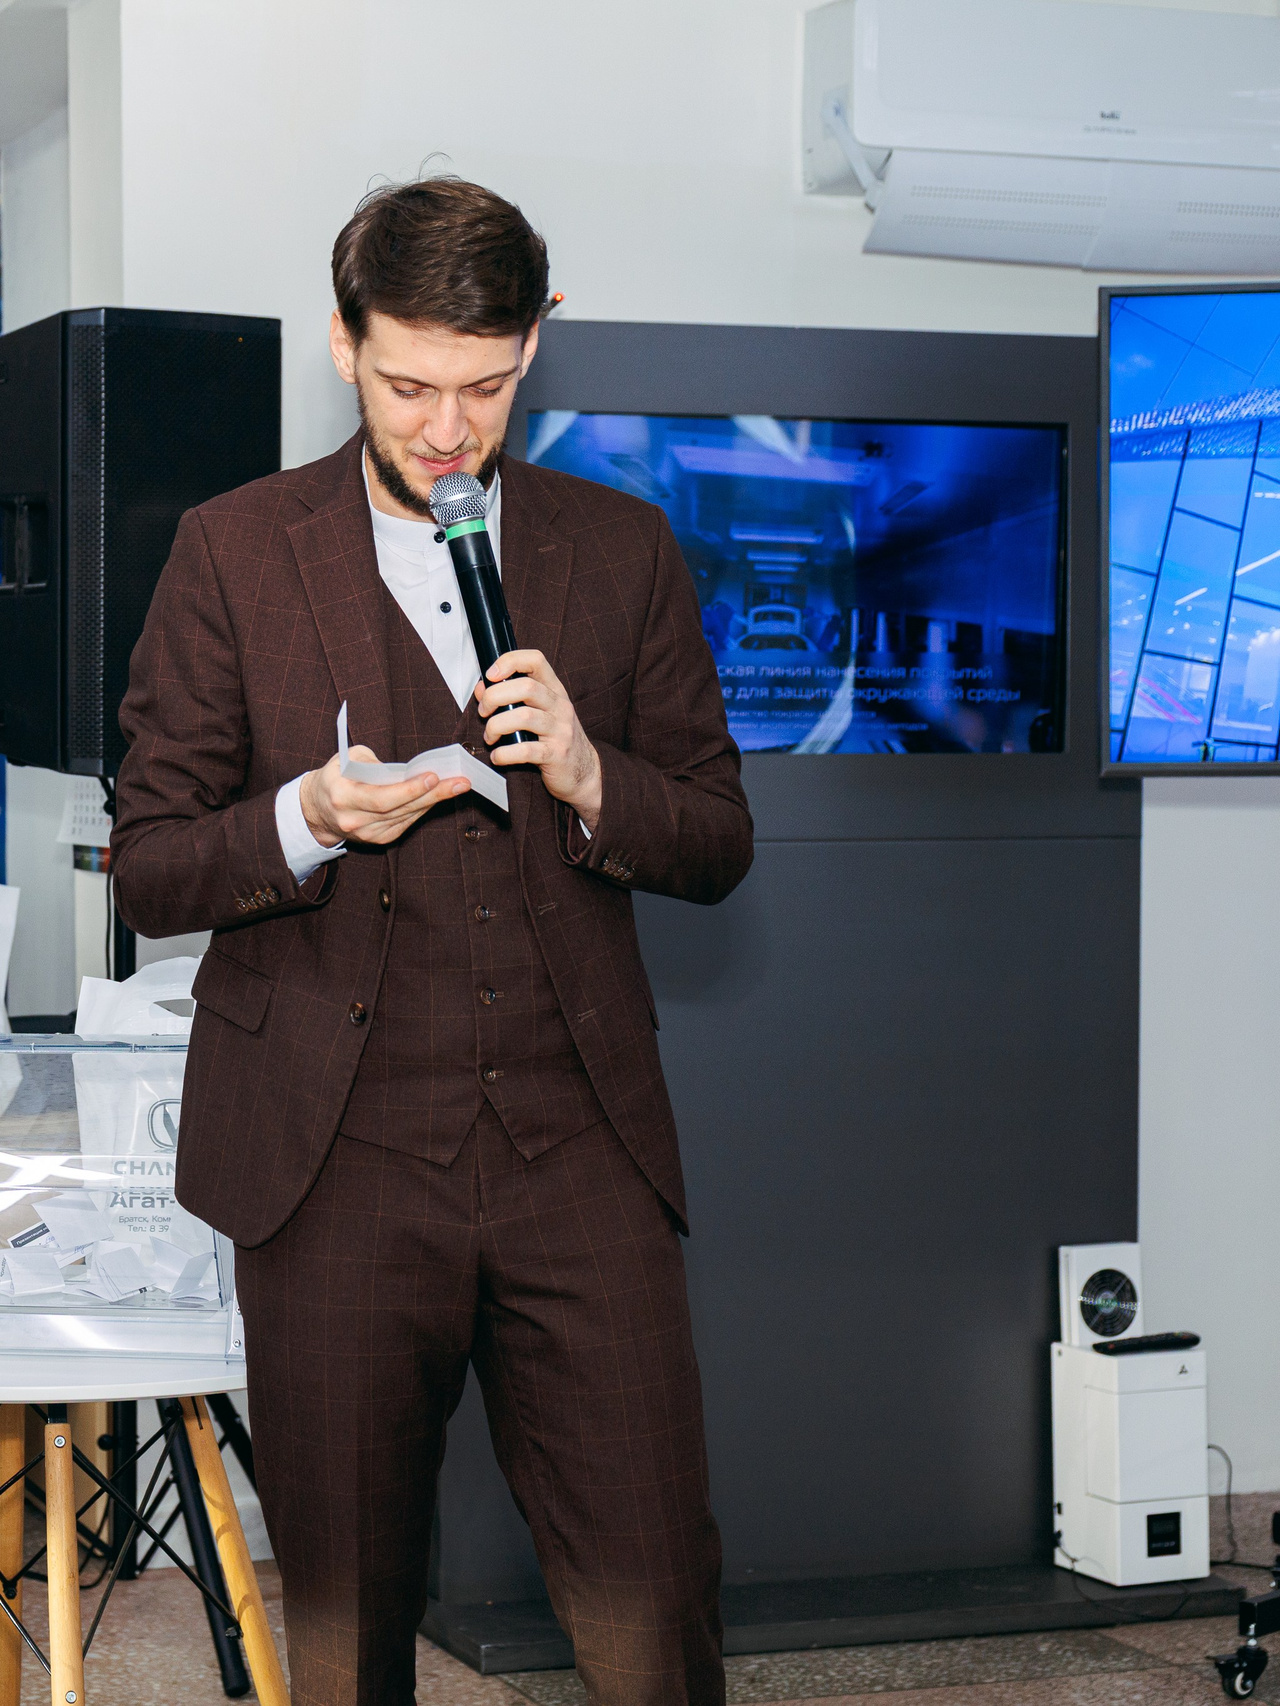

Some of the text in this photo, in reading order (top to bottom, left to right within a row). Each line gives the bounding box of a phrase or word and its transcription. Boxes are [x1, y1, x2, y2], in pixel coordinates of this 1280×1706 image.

[760, 666, 811, 678] линия
[815, 666, 906, 679] нансения
[736, 687, 769, 700] для
[967, 688, 1020, 703] среды
[118, 1215, 149, 1223] Братск,
